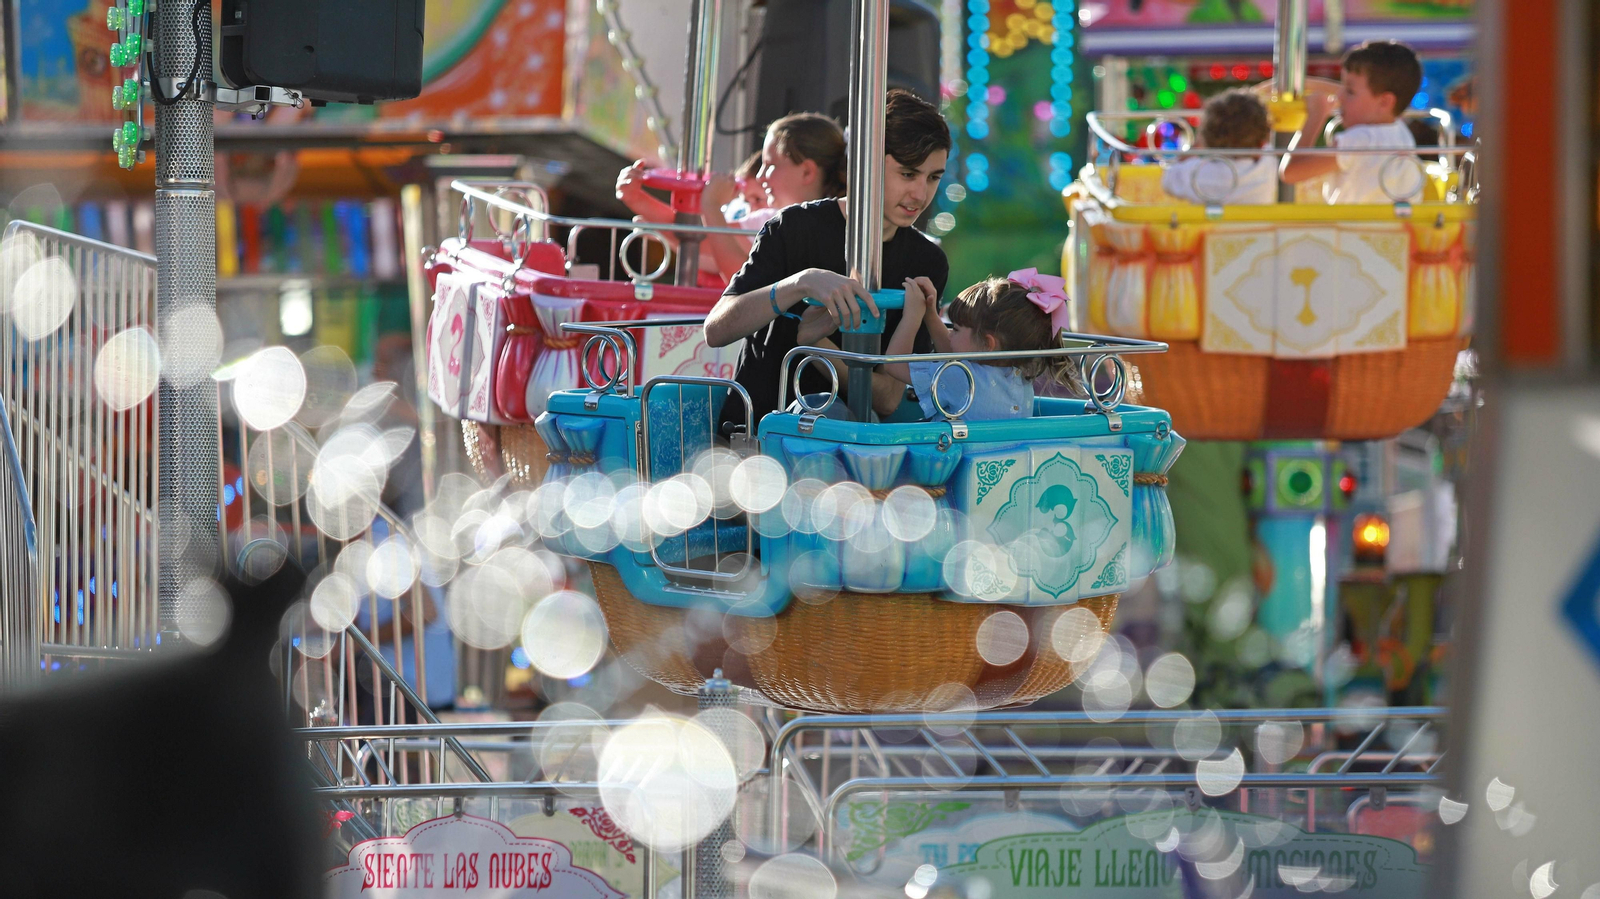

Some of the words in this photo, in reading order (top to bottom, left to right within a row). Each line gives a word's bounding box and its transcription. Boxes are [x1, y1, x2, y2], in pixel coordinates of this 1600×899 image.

[1289, 266, 1321, 327] 1
[447, 312, 465, 378] 2
[1034, 484, 1078, 559] 3
[360, 852, 434, 893] SIENTE
[443, 852, 479, 893] LAS
[488, 852, 552, 893] NUBES
[1008, 848, 1082, 888] VIAJE
[1246, 849, 1378, 893] MOCIONES
